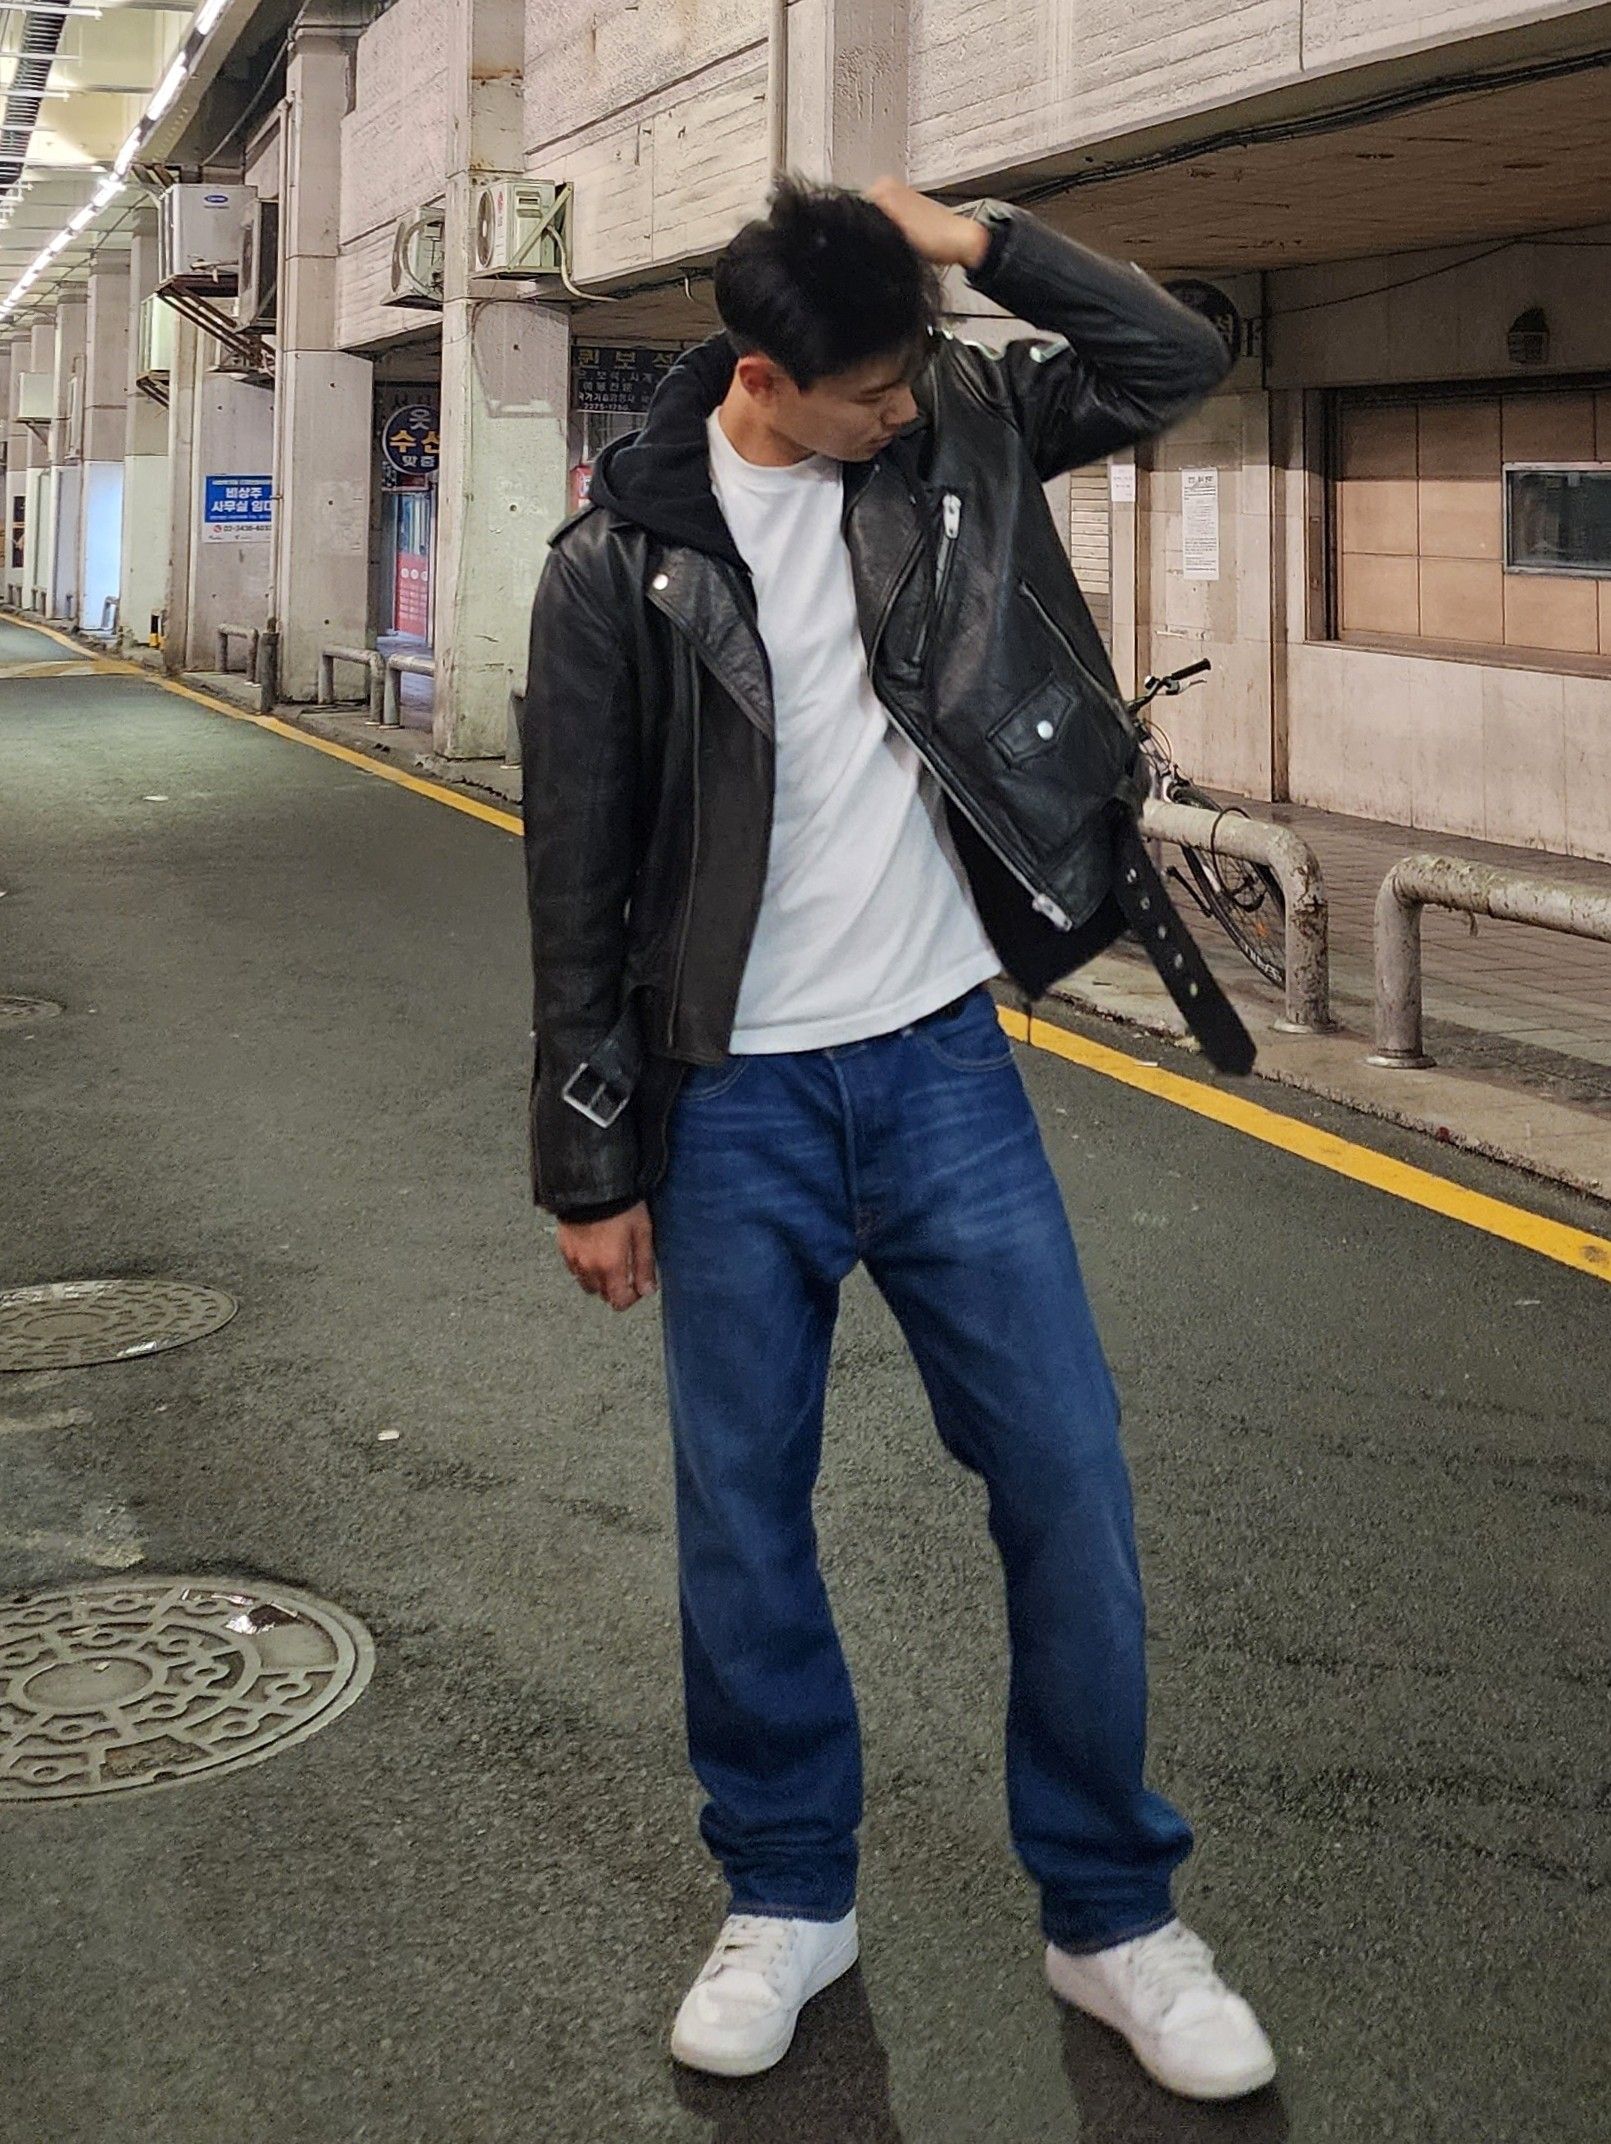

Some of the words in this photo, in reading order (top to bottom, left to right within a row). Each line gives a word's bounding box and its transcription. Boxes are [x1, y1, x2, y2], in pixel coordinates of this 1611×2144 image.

[409, 408, 430, 430] 옷
[389, 430, 440, 453] 수선
[211, 500, 249, 512] 사무실
